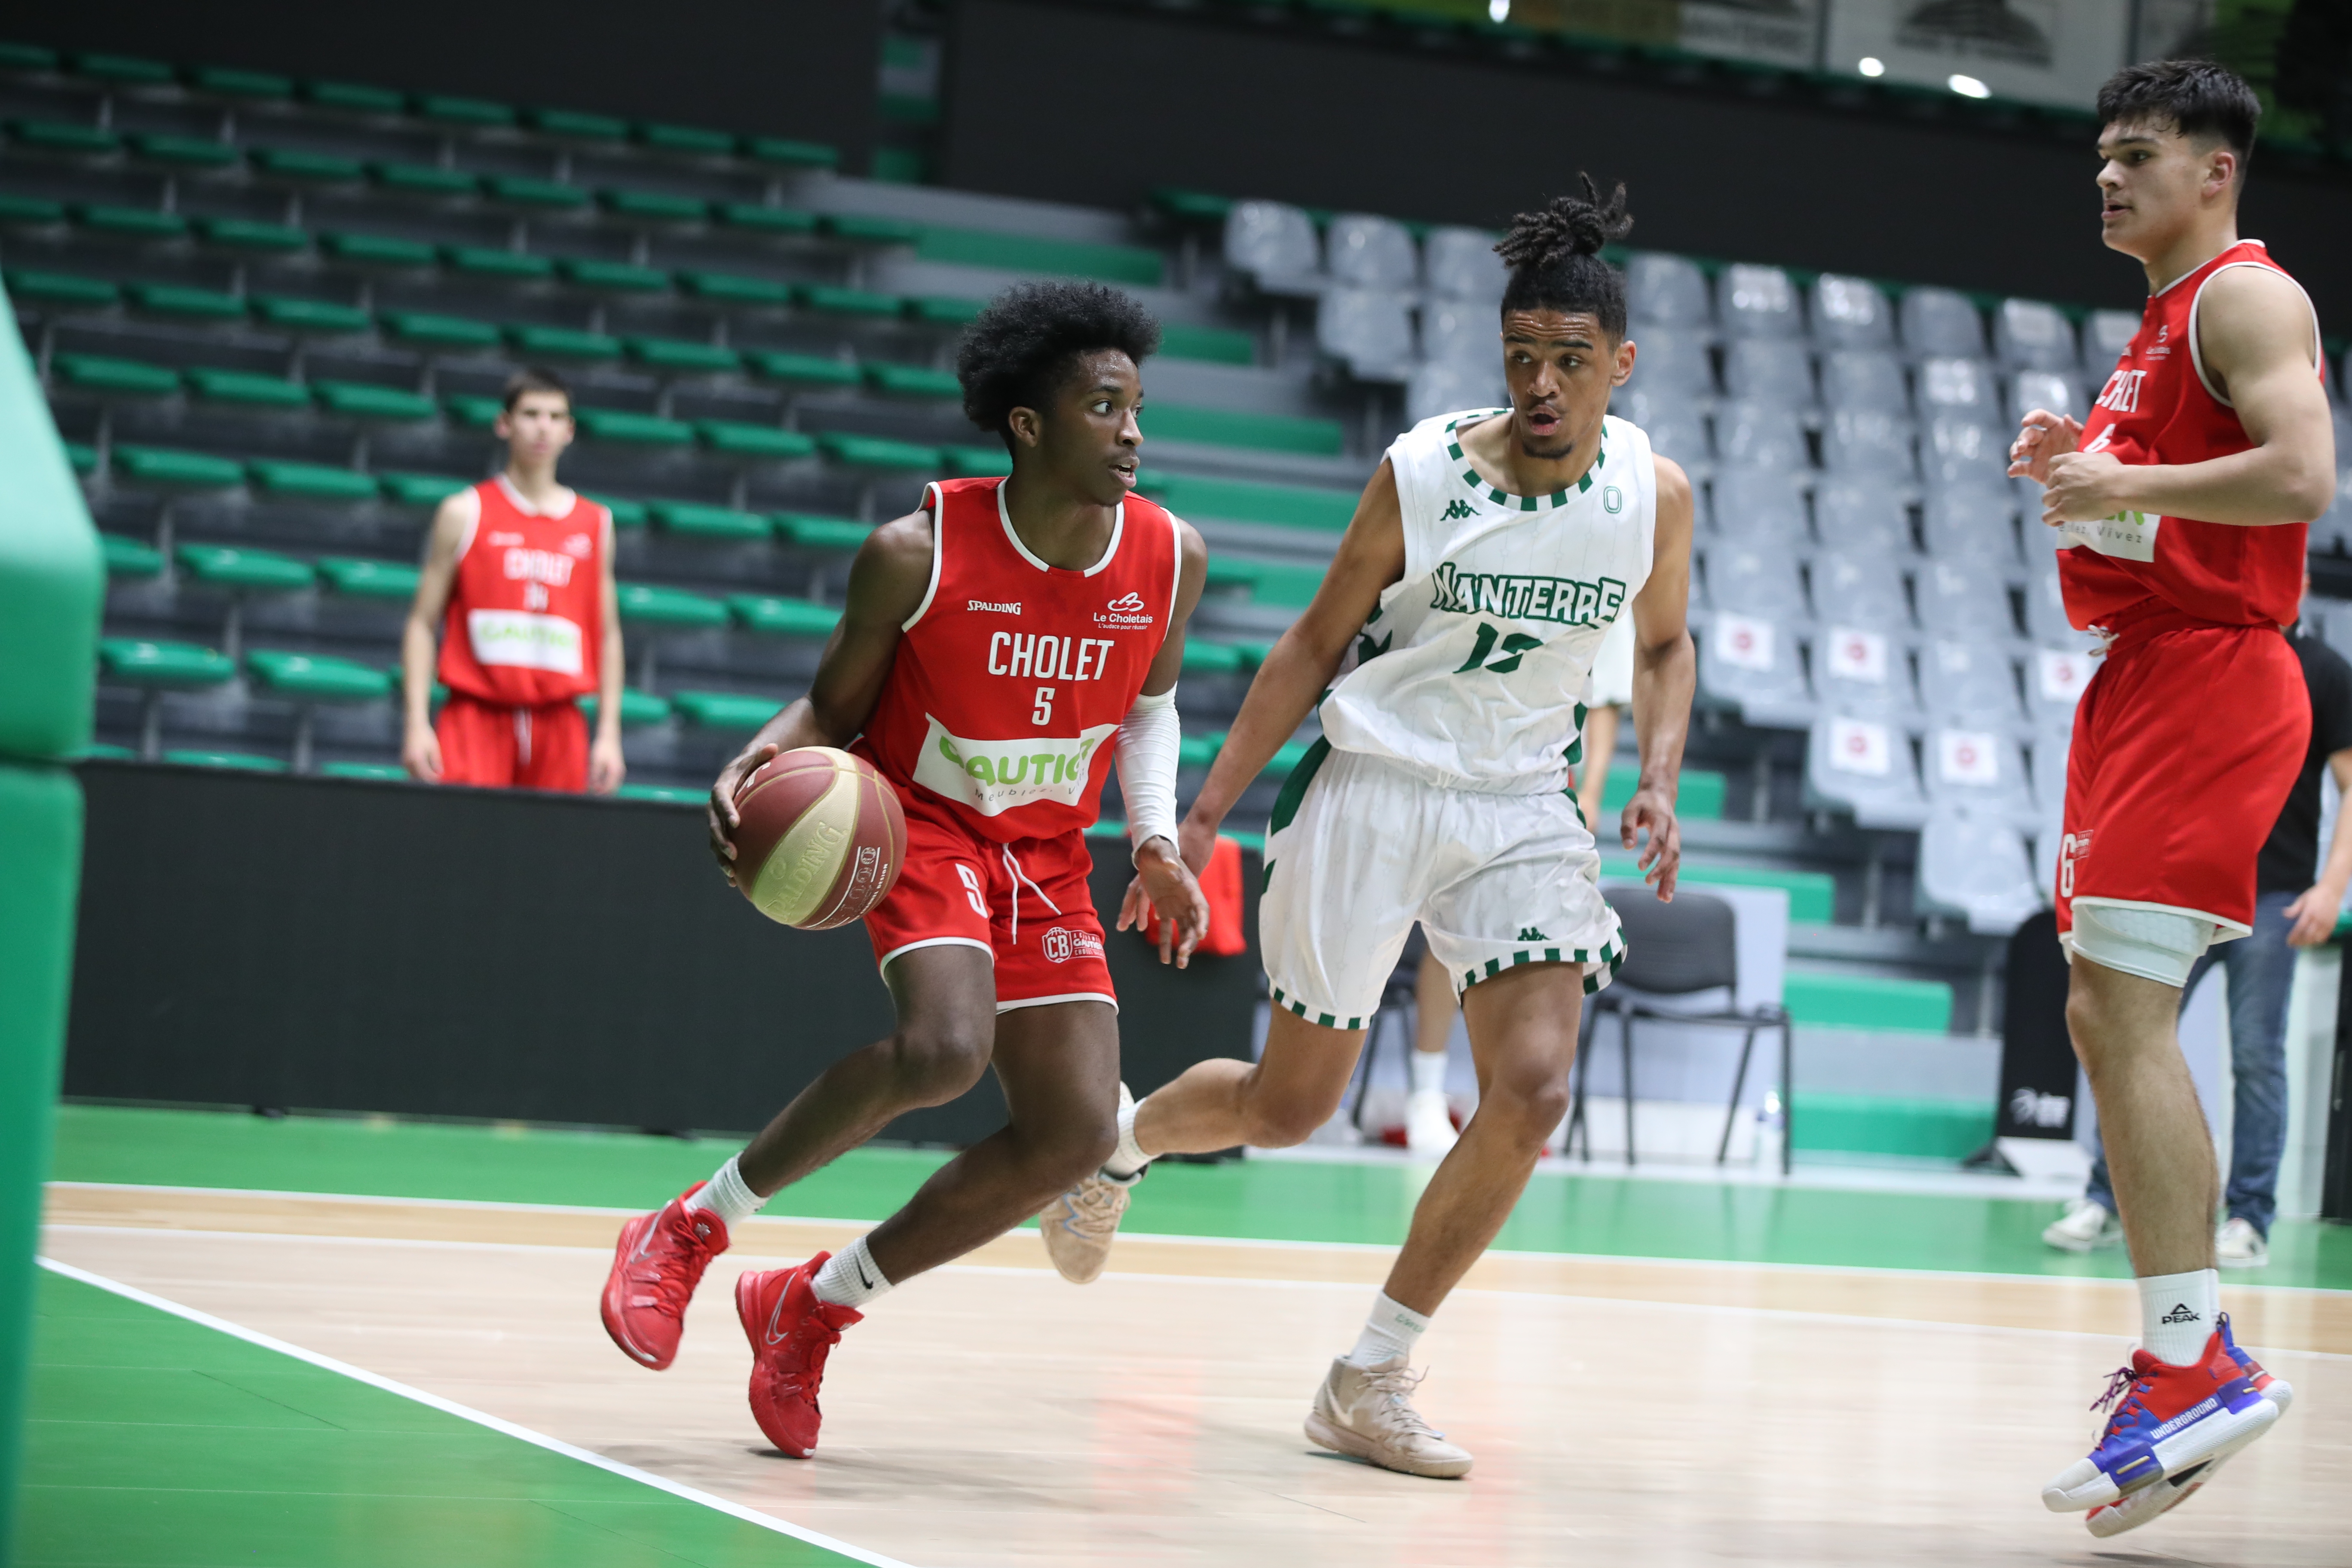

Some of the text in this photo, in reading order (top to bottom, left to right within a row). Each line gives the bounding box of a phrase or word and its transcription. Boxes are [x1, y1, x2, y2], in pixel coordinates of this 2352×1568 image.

[967, 600, 1021, 615] SPALDING
[1430, 561, 1626, 630] NANTERRE
[1093, 612, 1154, 623] Le Choletais
[988, 631, 1115, 681] CHOLET
[1032, 687, 1056, 726] 5
[2060, 833, 2078, 898] 6
[955, 863, 989, 919] 5
[1047, 934, 1070, 958] CB
[2162, 1312, 2201, 1324] PEAK
[2150, 1397, 2218, 1440] UNDERGROUND
